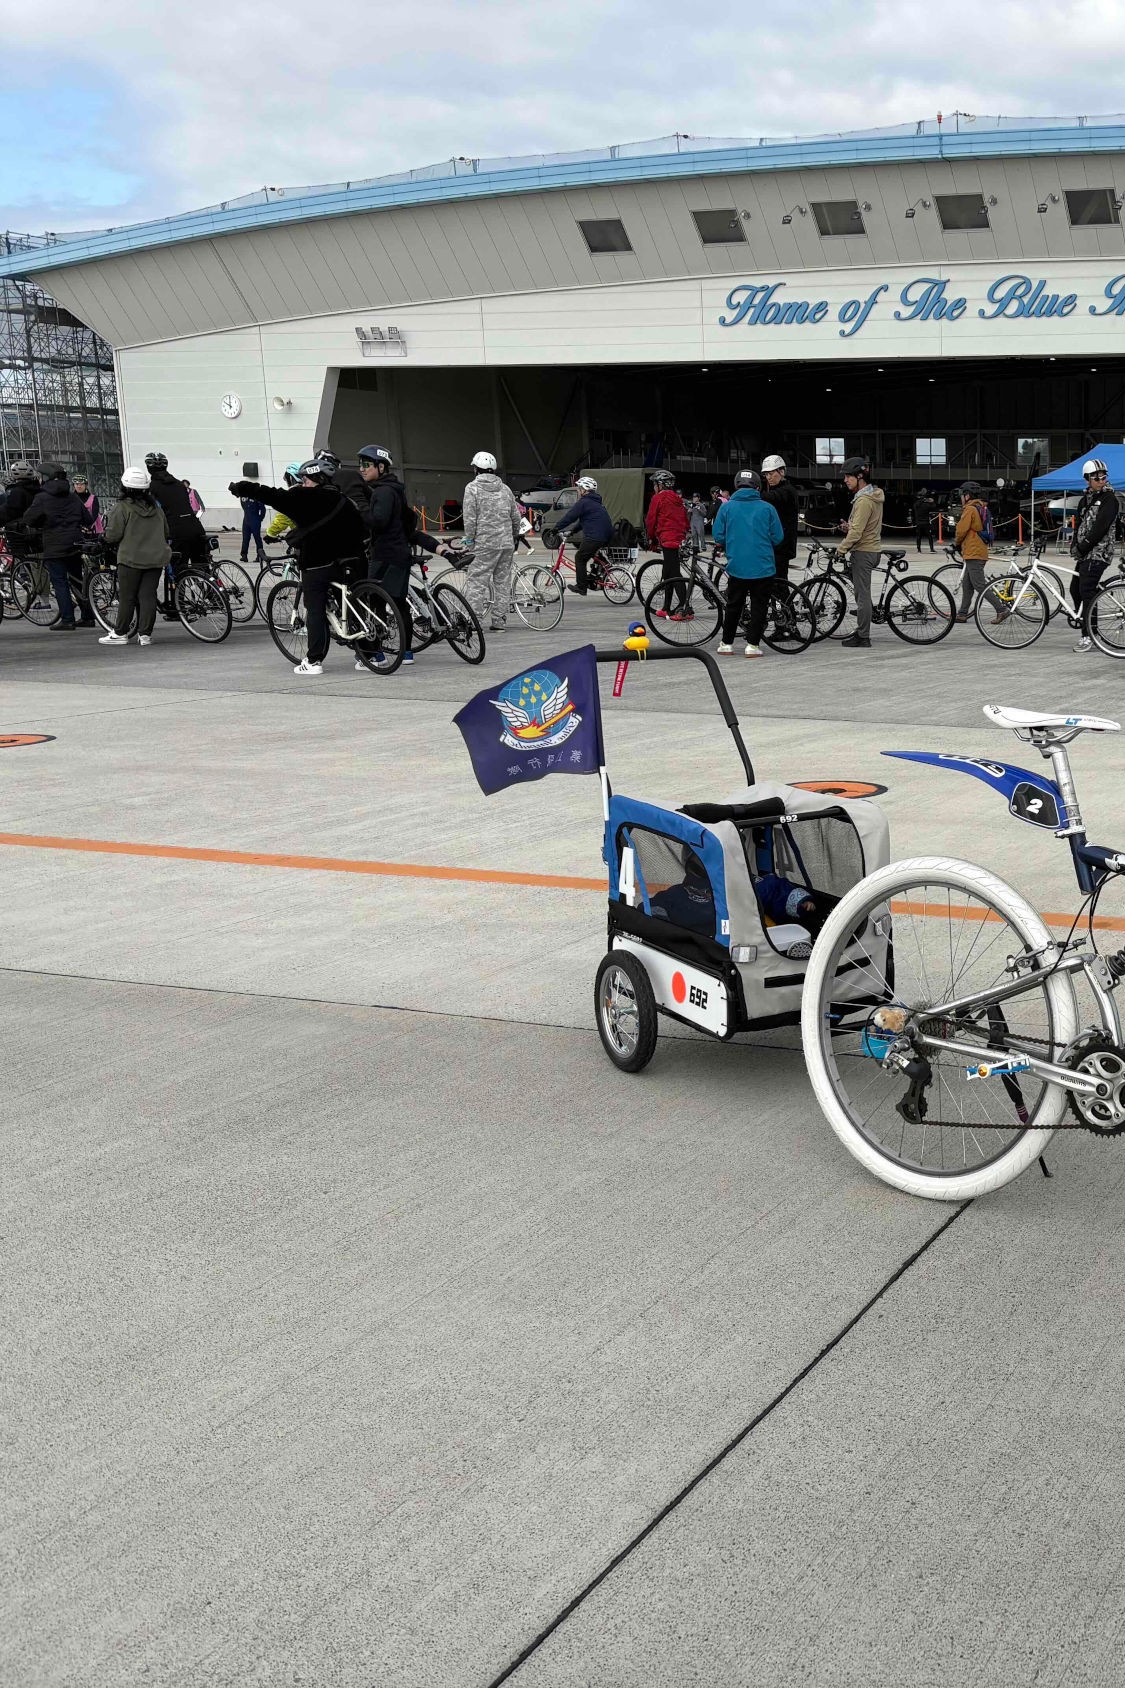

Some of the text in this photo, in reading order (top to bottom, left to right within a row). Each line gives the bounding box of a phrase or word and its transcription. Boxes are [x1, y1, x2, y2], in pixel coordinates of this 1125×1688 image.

[718, 282, 829, 328] Home
[837, 284, 889, 338] of
[893, 276, 968, 321] The
[977, 273, 1078, 320] Blue
[1026, 798, 1044, 814] 2
[780, 814, 798, 824] 692
[688, 984, 708, 1010] 692
